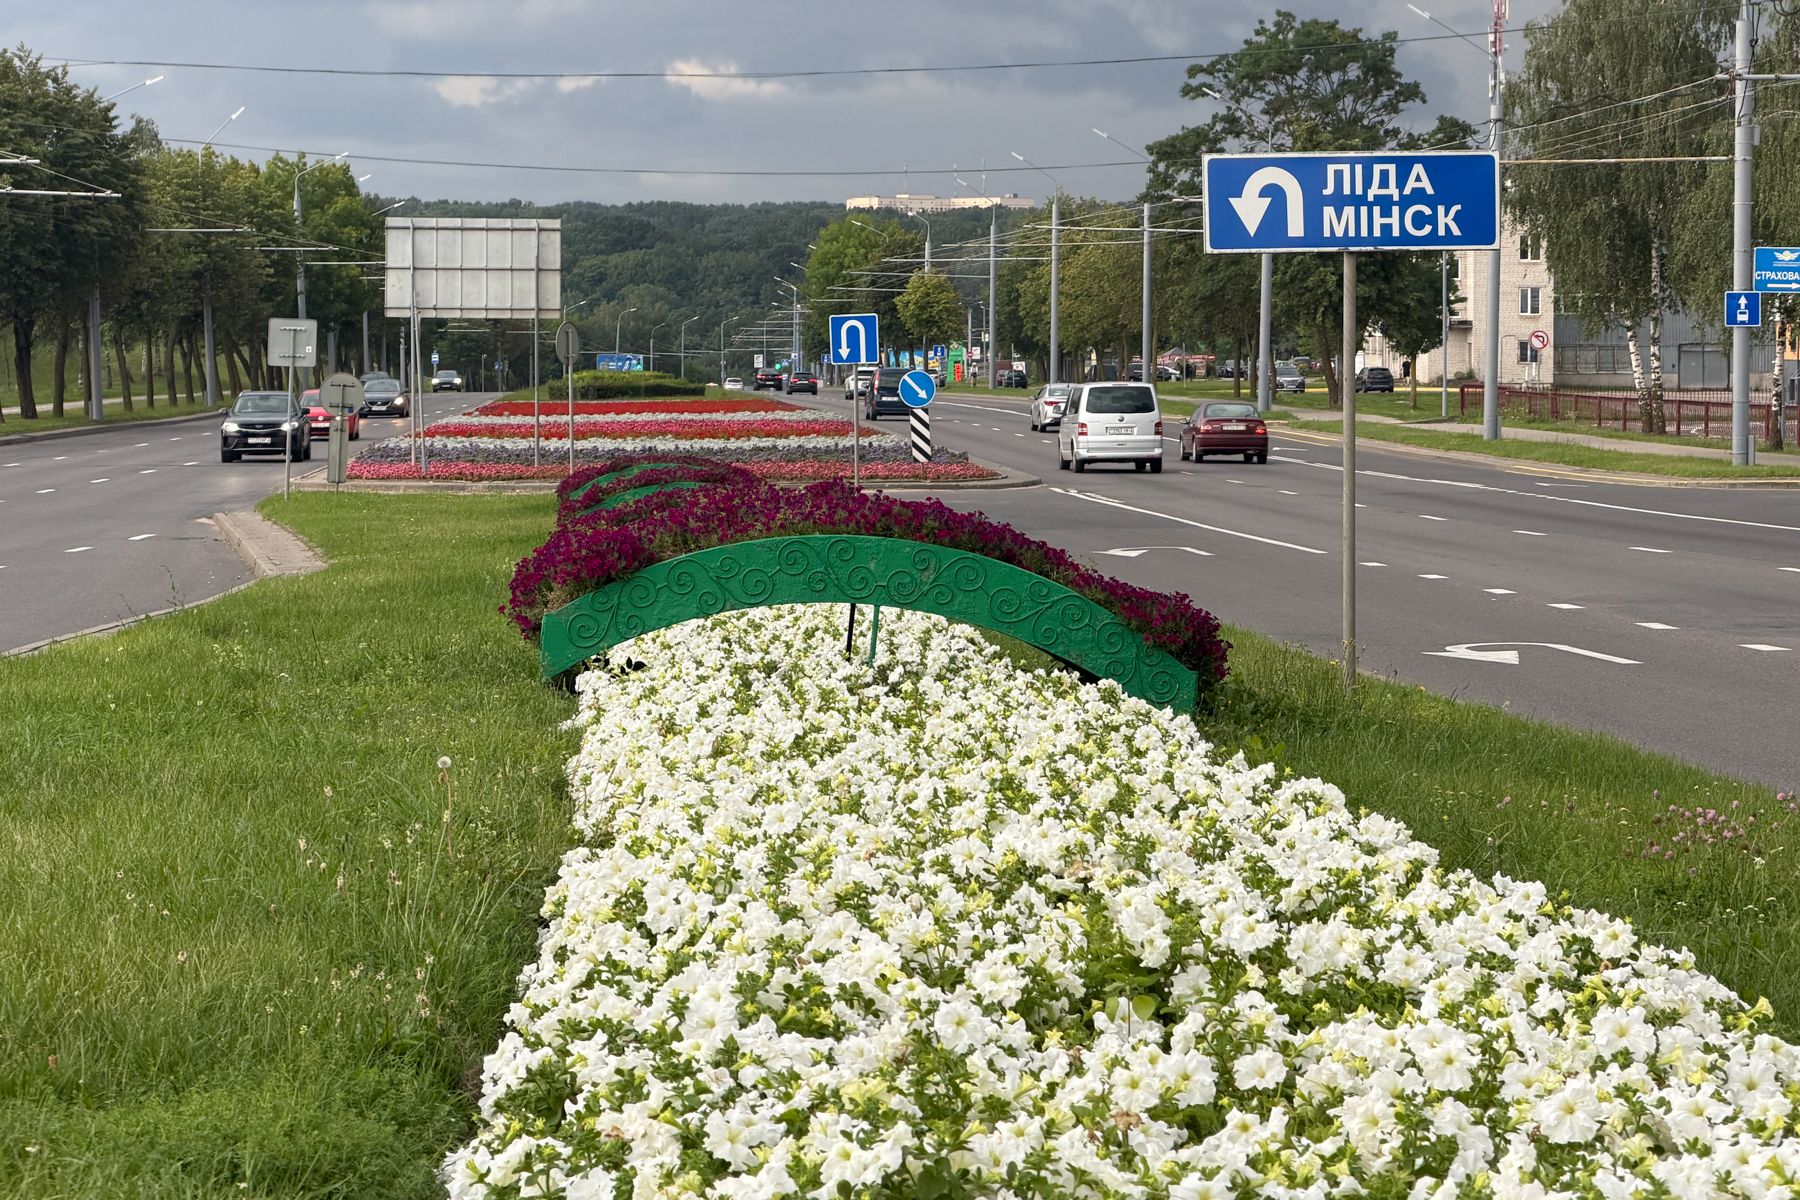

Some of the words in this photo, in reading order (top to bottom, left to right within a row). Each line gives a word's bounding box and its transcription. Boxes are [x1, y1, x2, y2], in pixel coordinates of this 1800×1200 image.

[1322, 163, 1435, 202] ЛІДА
[1322, 204, 1462, 238] МІНСК
[1755, 271, 1800, 281] СТРАХОВА
